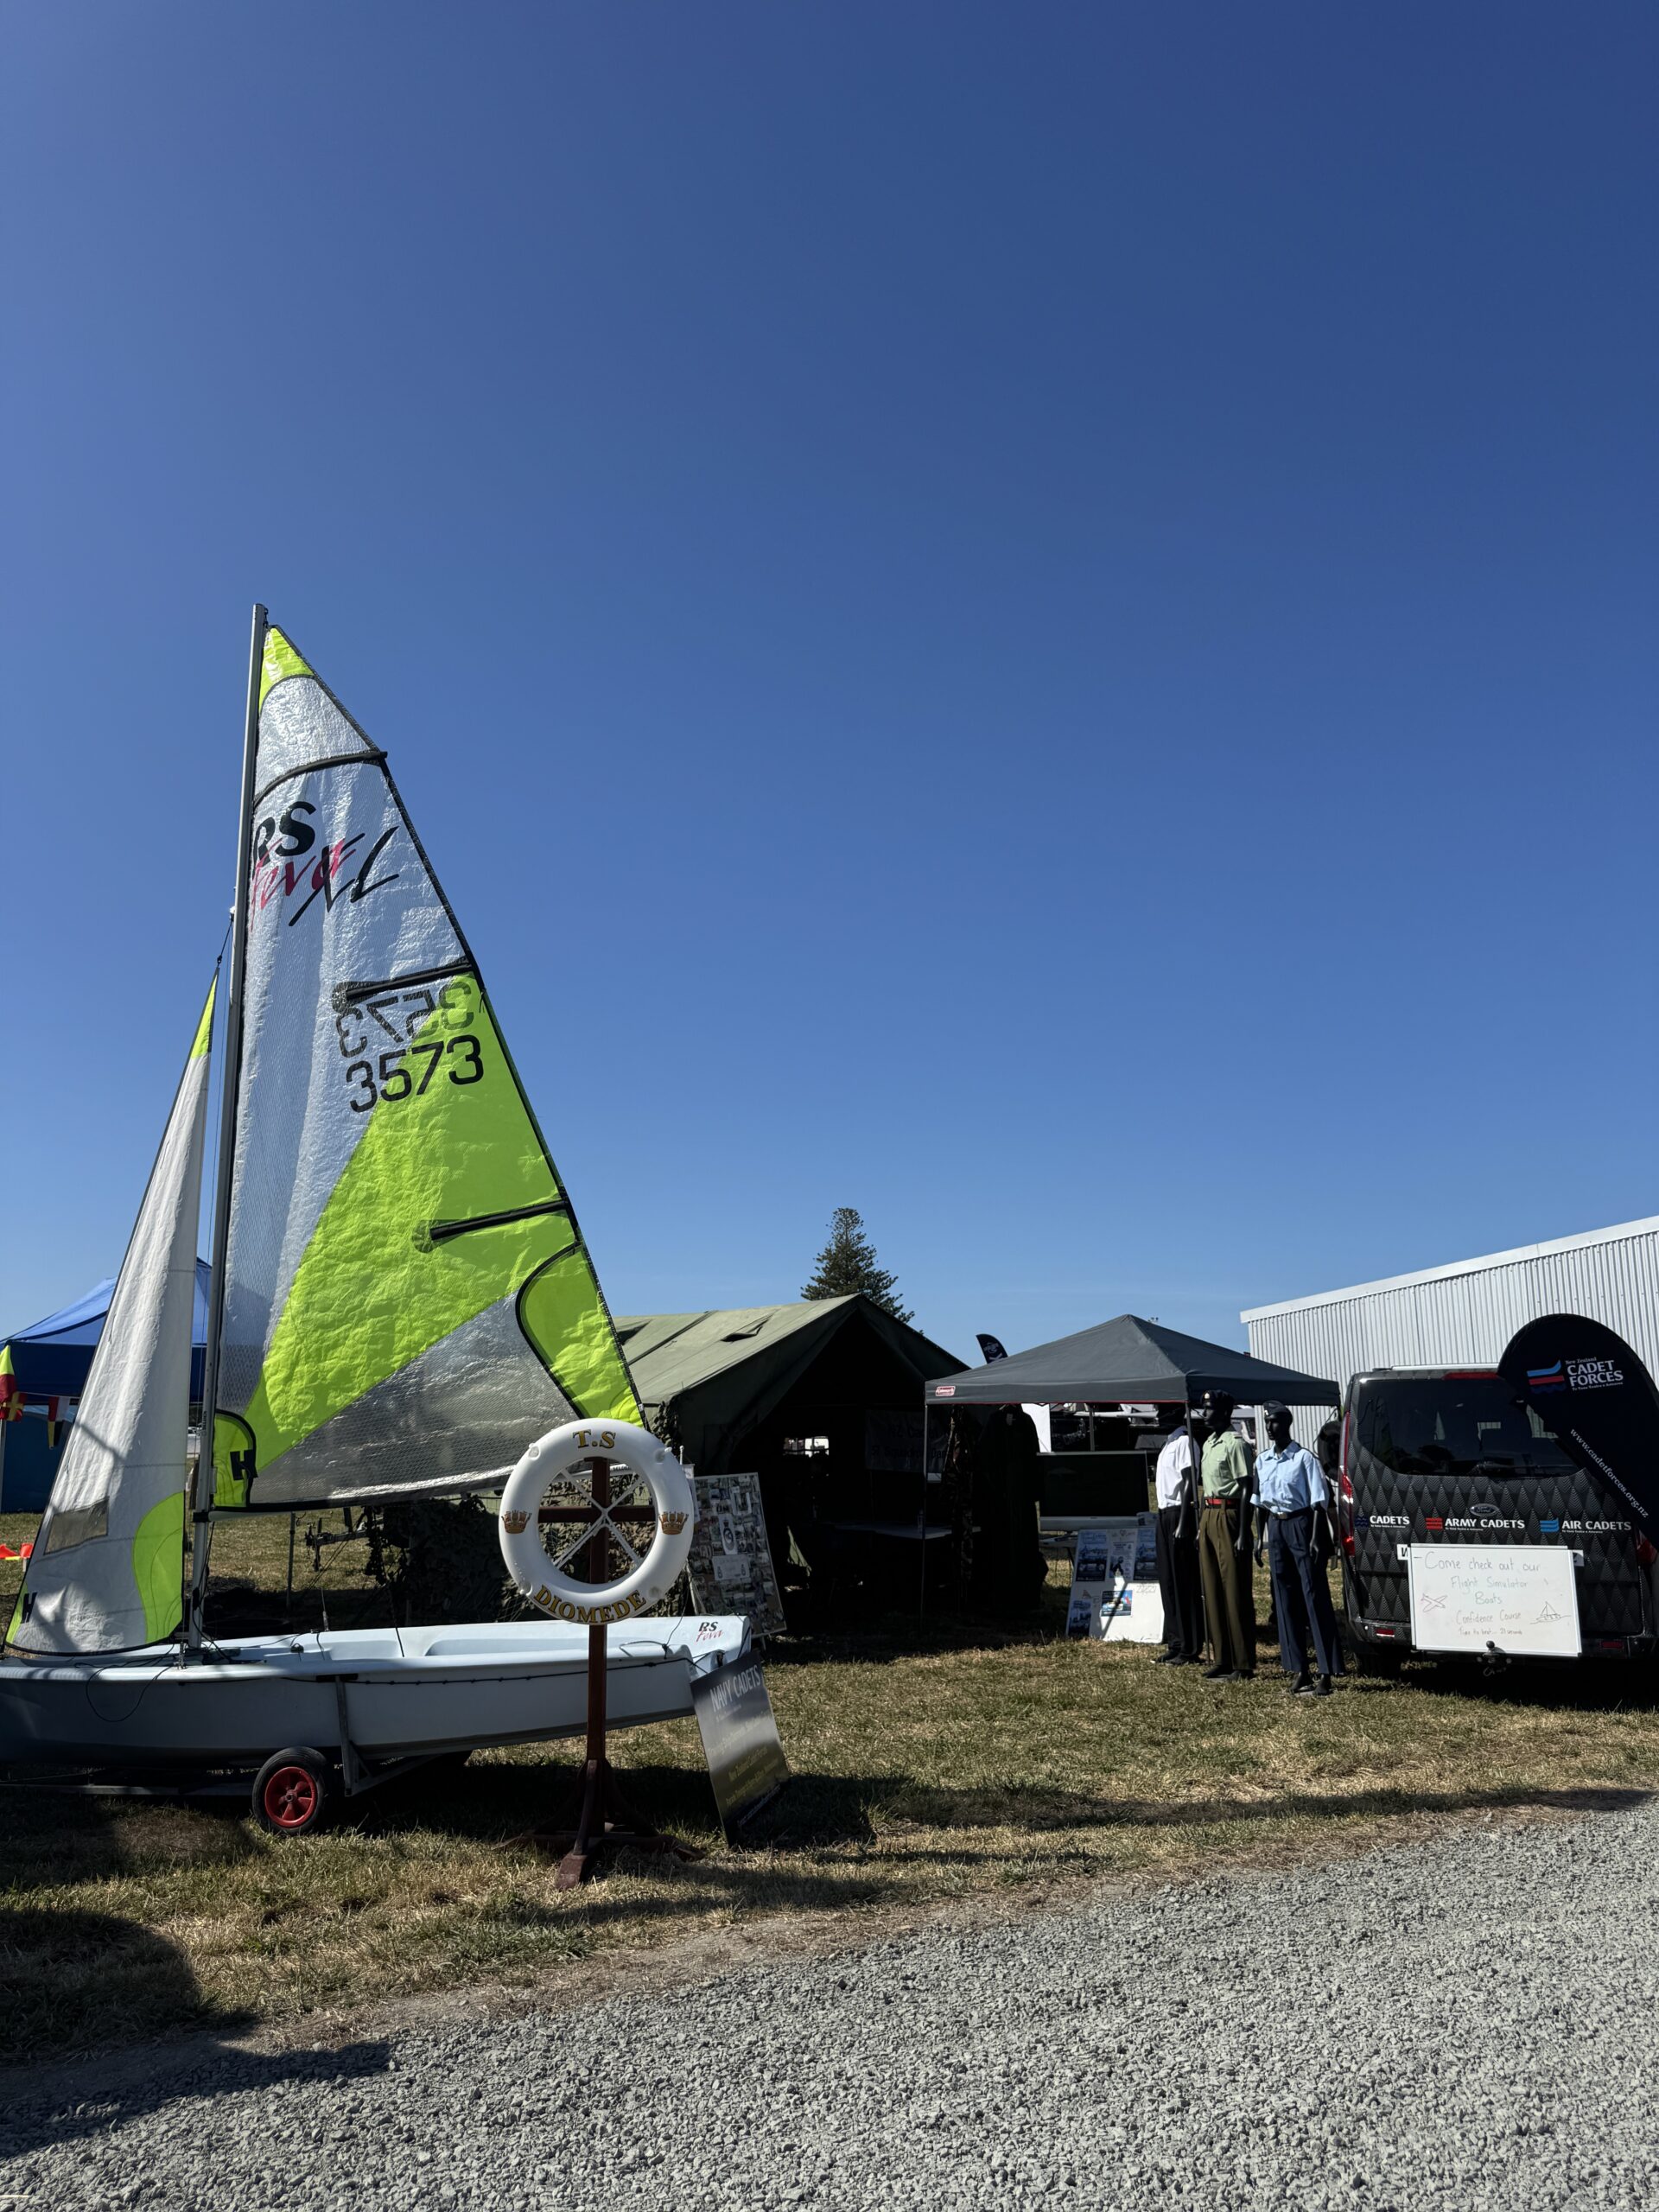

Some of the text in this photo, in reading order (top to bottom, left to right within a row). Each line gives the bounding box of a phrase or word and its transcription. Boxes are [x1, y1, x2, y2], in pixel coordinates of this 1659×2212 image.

[251, 801, 316, 880] RS
[346, 1034, 484, 1113] 3573
[1567, 1359, 1615, 1376] CADET
[1569, 1370, 1624, 1387] FORCES
[1570, 1428, 1649, 1518] www.cadetforces.org.nz
[1370, 1515, 1410, 1525] CADETS
[1445, 1517, 1477, 1528] ARMY
[1480, 1518, 1525, 1529] CADETS
[1561, 1520, 1632, 1531] AIR CADETS
[1424, 1551, 1461, 1570] Come
[1469, 1557, 1493, 1570] check
[1498, 1557, 1515, 1571] out
[1522, 1561, 1541, 1572] our
[1451, 1575, 1529, 1594] Flight Simulator
[532, 1584, 647, 1624] DIOMEDE
[1474, 1591, 1503, 1605] Boats
[1455, 1609, 1522, 1624] Confidence Course
[698, 1621, 719, 1632] RS
[709, 1664, 761, 1713] NAVY CADETS
